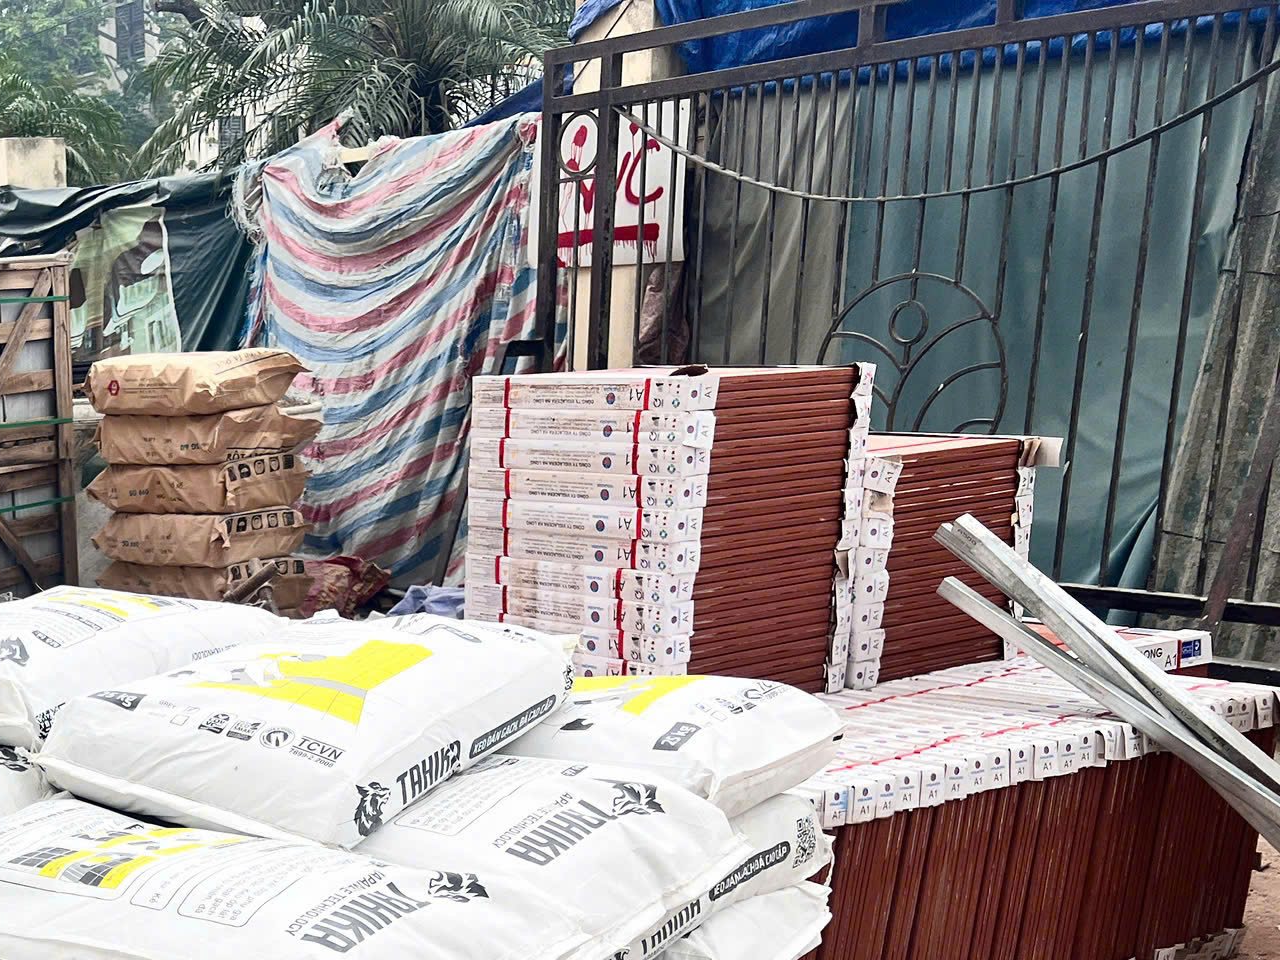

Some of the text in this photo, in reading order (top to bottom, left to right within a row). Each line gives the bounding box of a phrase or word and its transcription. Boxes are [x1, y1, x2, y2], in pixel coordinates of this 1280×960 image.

[629, 388, 644, 401] A1
[884, 470, 894, 483] A1
[618, 517, 632, 530] A1
[618, 548, 631, 560] A1
[1143, 647, 1177, 667] ONG A1
[118, 692, 137, 708] kg
[296, 738, 343, 760] TCVN
[1081, 752, 1090, 761] A1
[1042, 762, 1052, 771] A1
[1064, 759, 1073, 768] A1
[1017, 766, 1026, 775] A1
[974, 776, 983, 786] A1
[994, 772, 1003, 782] A1
[951, 783, 960, 792] A1
[903, 793, 912, 803] A1
[928, 789, 938, 799] A1
[860, 805, 870, 815] A1
[882, 800, 892, 811] A1
[505, 799, 618, 866] TAHIKA
[285, 894, 341, 936] TECHNOLOGY
[300, 881, 432, 953] TAHIKA
